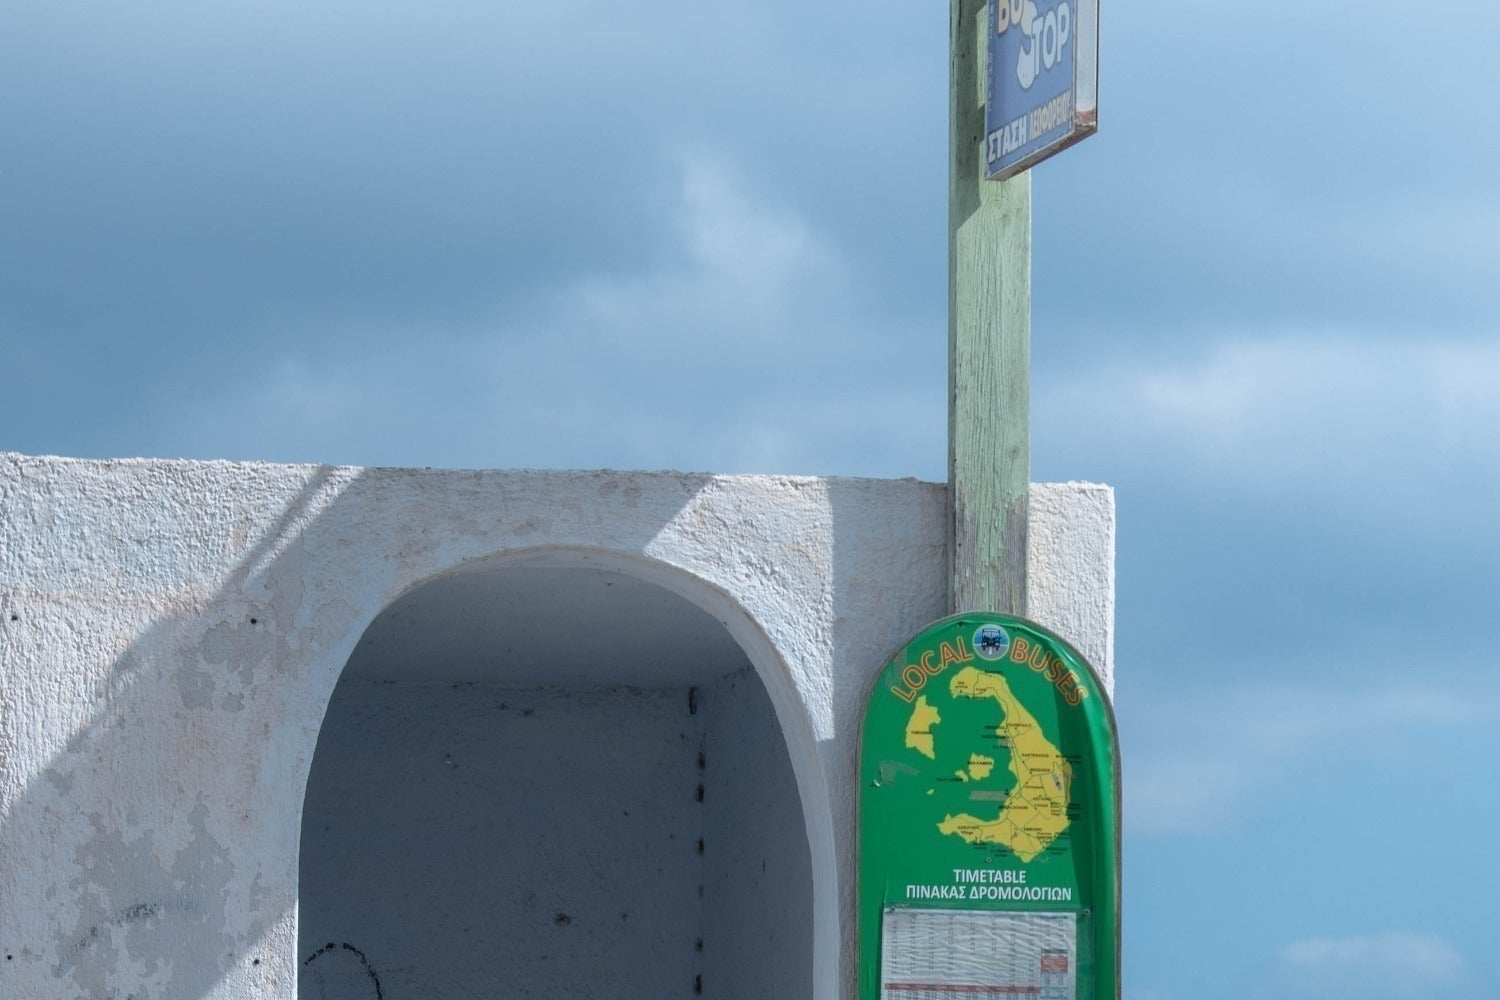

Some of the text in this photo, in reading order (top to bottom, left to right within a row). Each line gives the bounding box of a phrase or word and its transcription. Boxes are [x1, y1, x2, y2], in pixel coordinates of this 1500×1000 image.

[988, 114, 1027, 163] ΣΤΑΣΗ
[891, 637, 1088, 706] LOCAL BUSES
[953, 869, 1026, 884] TIMETABLE
[906, 885, 1072, 901] ΠΙΝΑΚΑΣ ΔΡΟΜΟΛΟΓΙΩΝ
